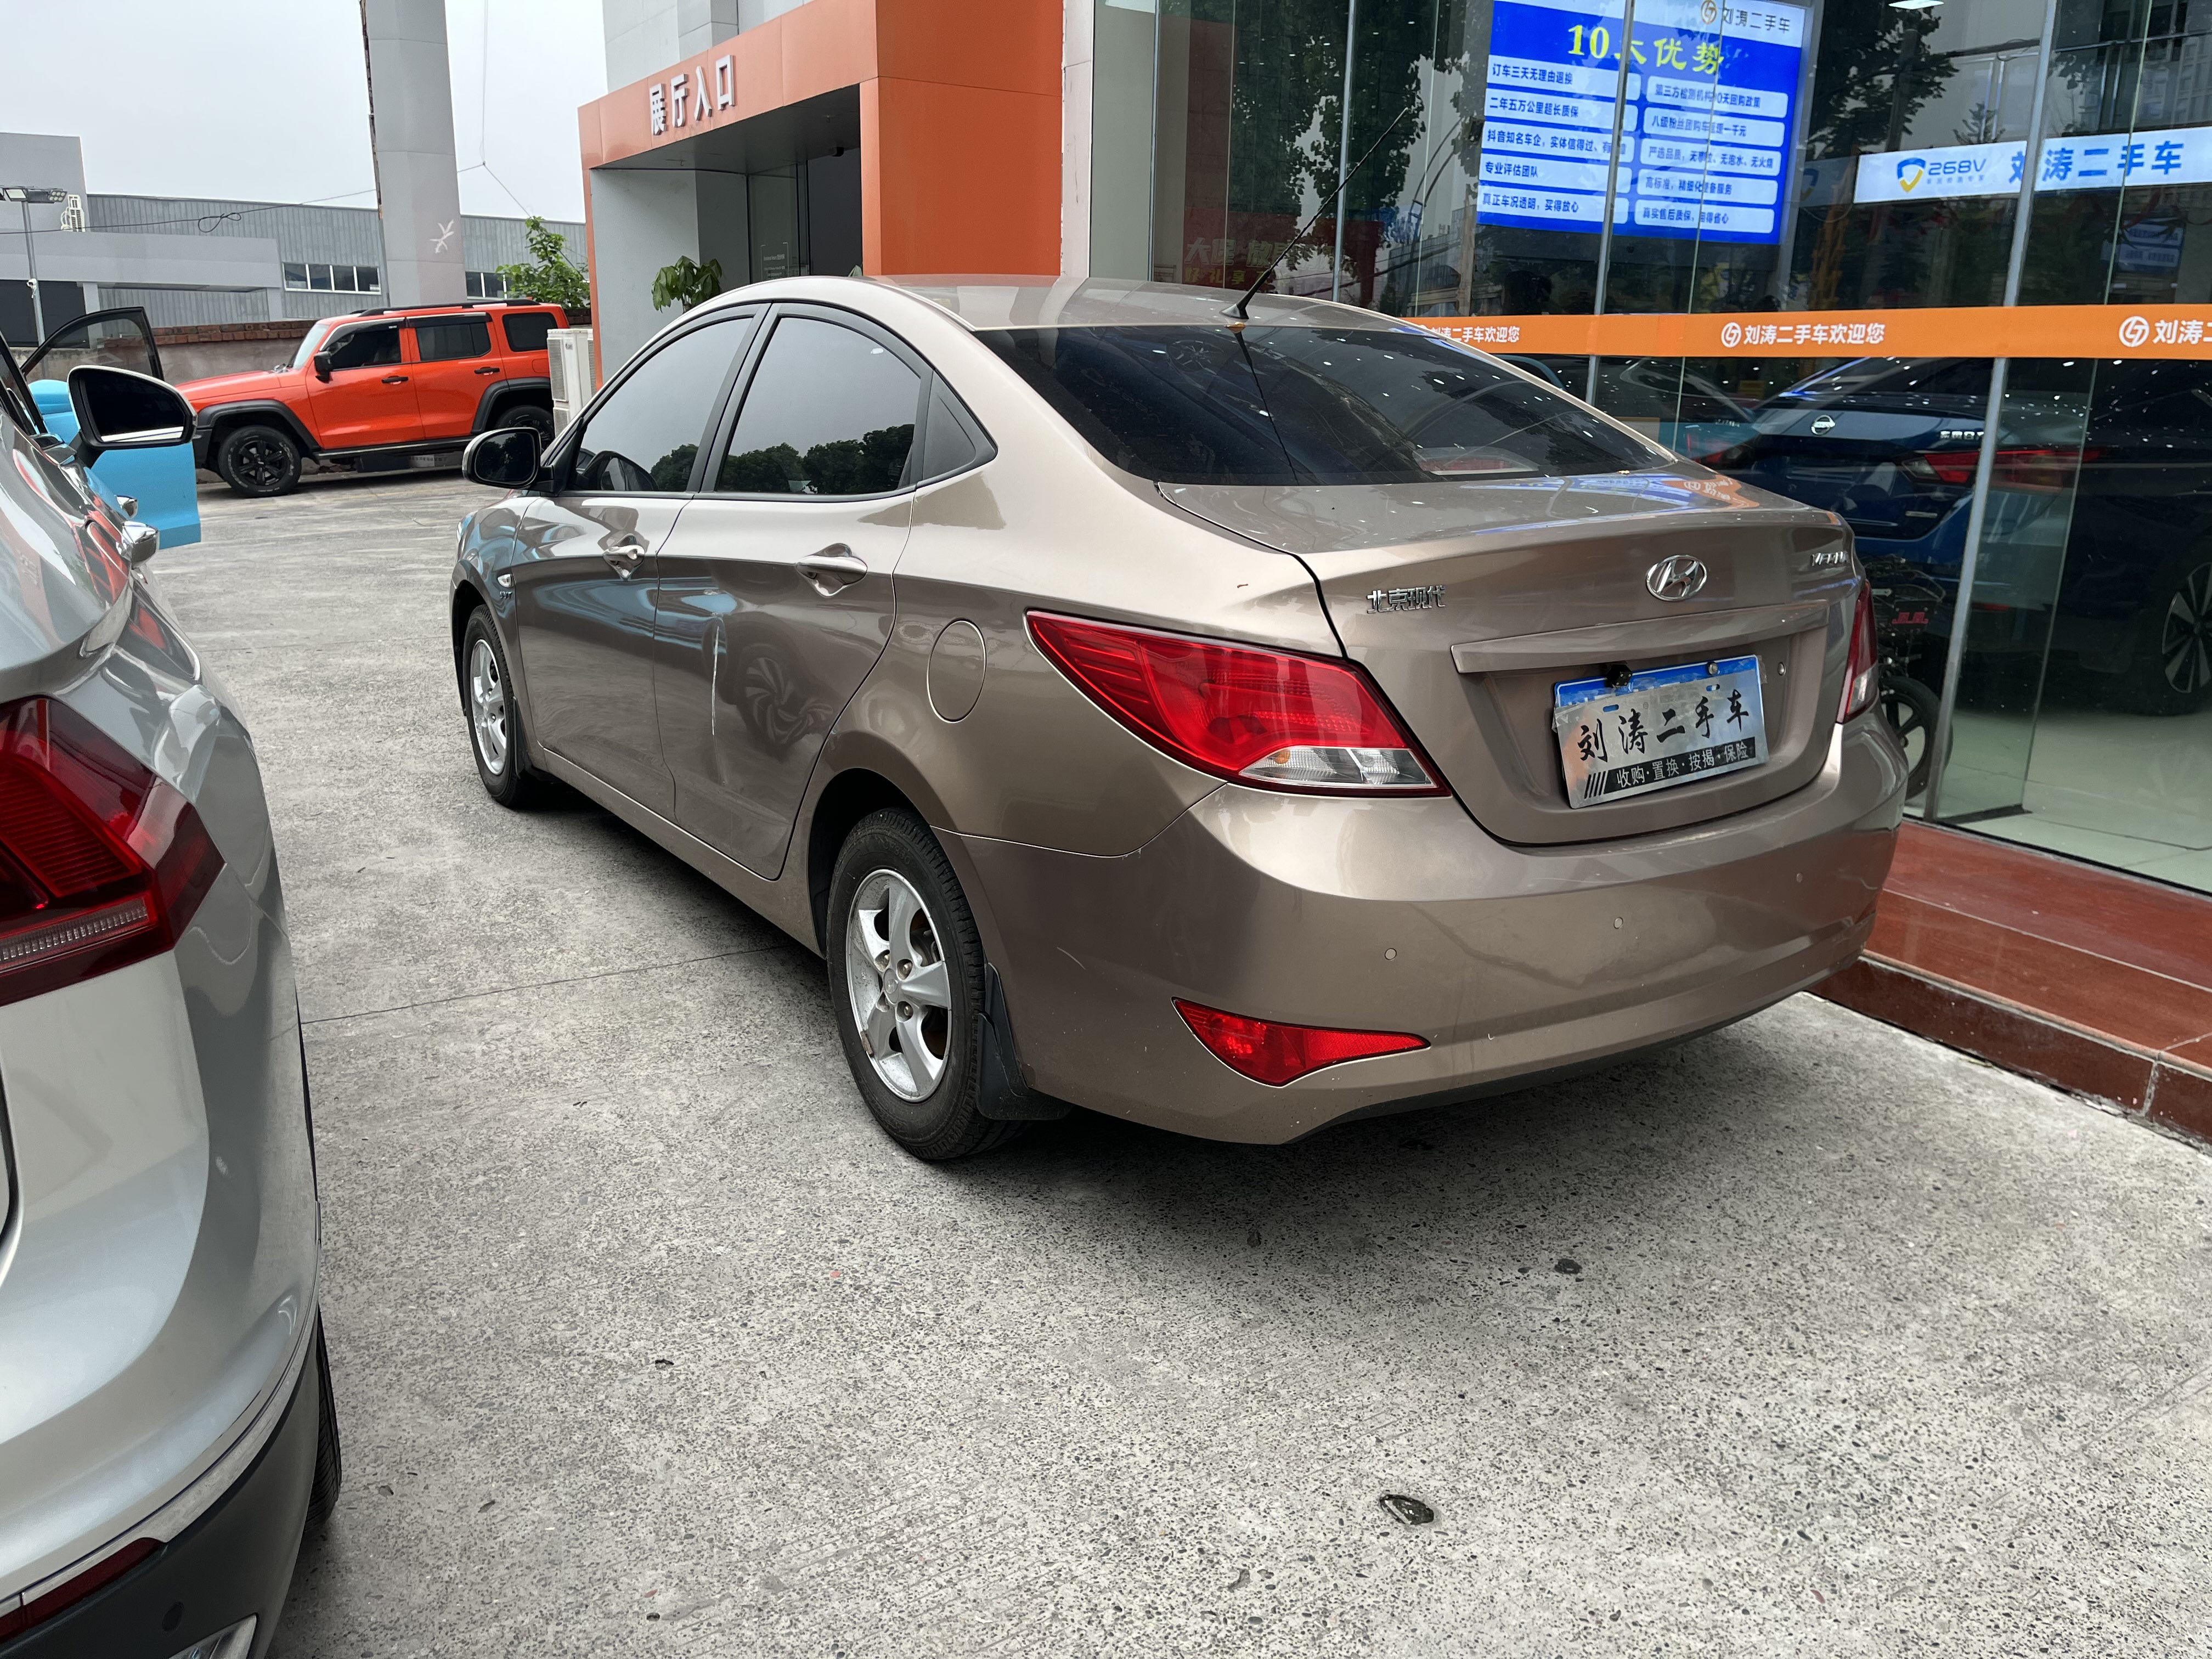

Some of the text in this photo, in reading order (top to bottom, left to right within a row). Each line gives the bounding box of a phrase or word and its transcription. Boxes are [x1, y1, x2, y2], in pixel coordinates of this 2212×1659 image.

[649, 54, 735, 136] 展厅入口
[1489, 97, 1579, 118] 二年五万公里超长质保
[1485, 161, 1538, 178] 专业评估团队
[1928, 158, 1987, 176] 268V
[2008, 140, 2184, 184] 刘涛二手车
[1743, 323, 1886, 346] 刘涛二手车欢迎您
[1367, 585, 1446, 614] 北京现代
[1576, 689, 1749, 763] 刘涛二手车
